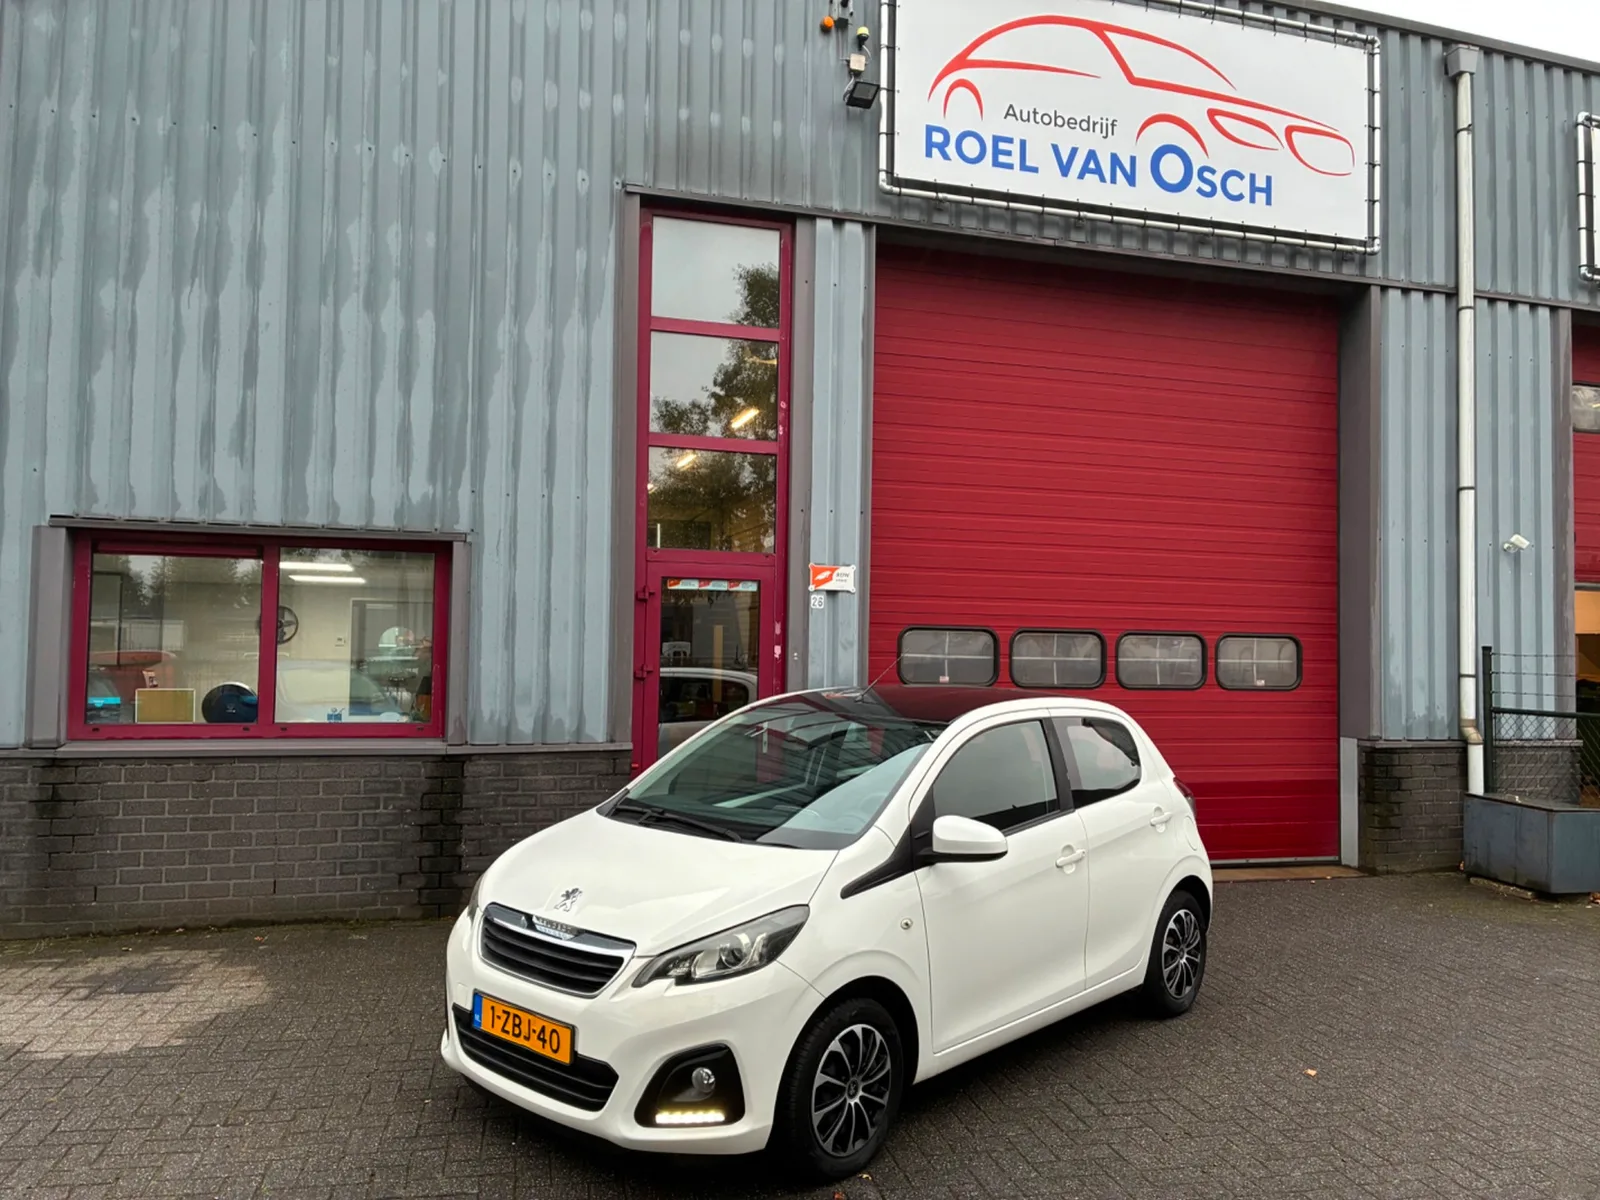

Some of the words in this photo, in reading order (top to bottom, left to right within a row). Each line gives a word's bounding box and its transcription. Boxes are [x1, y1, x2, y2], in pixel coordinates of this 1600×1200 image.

[1003, 103, 1118, 139] Autobedrijf
[925, 124, 1039, 174] ROEL
[1051, 143, 1137, 187] VAN
[490, 1005, 561, 1054] 1-ZBJ-40
